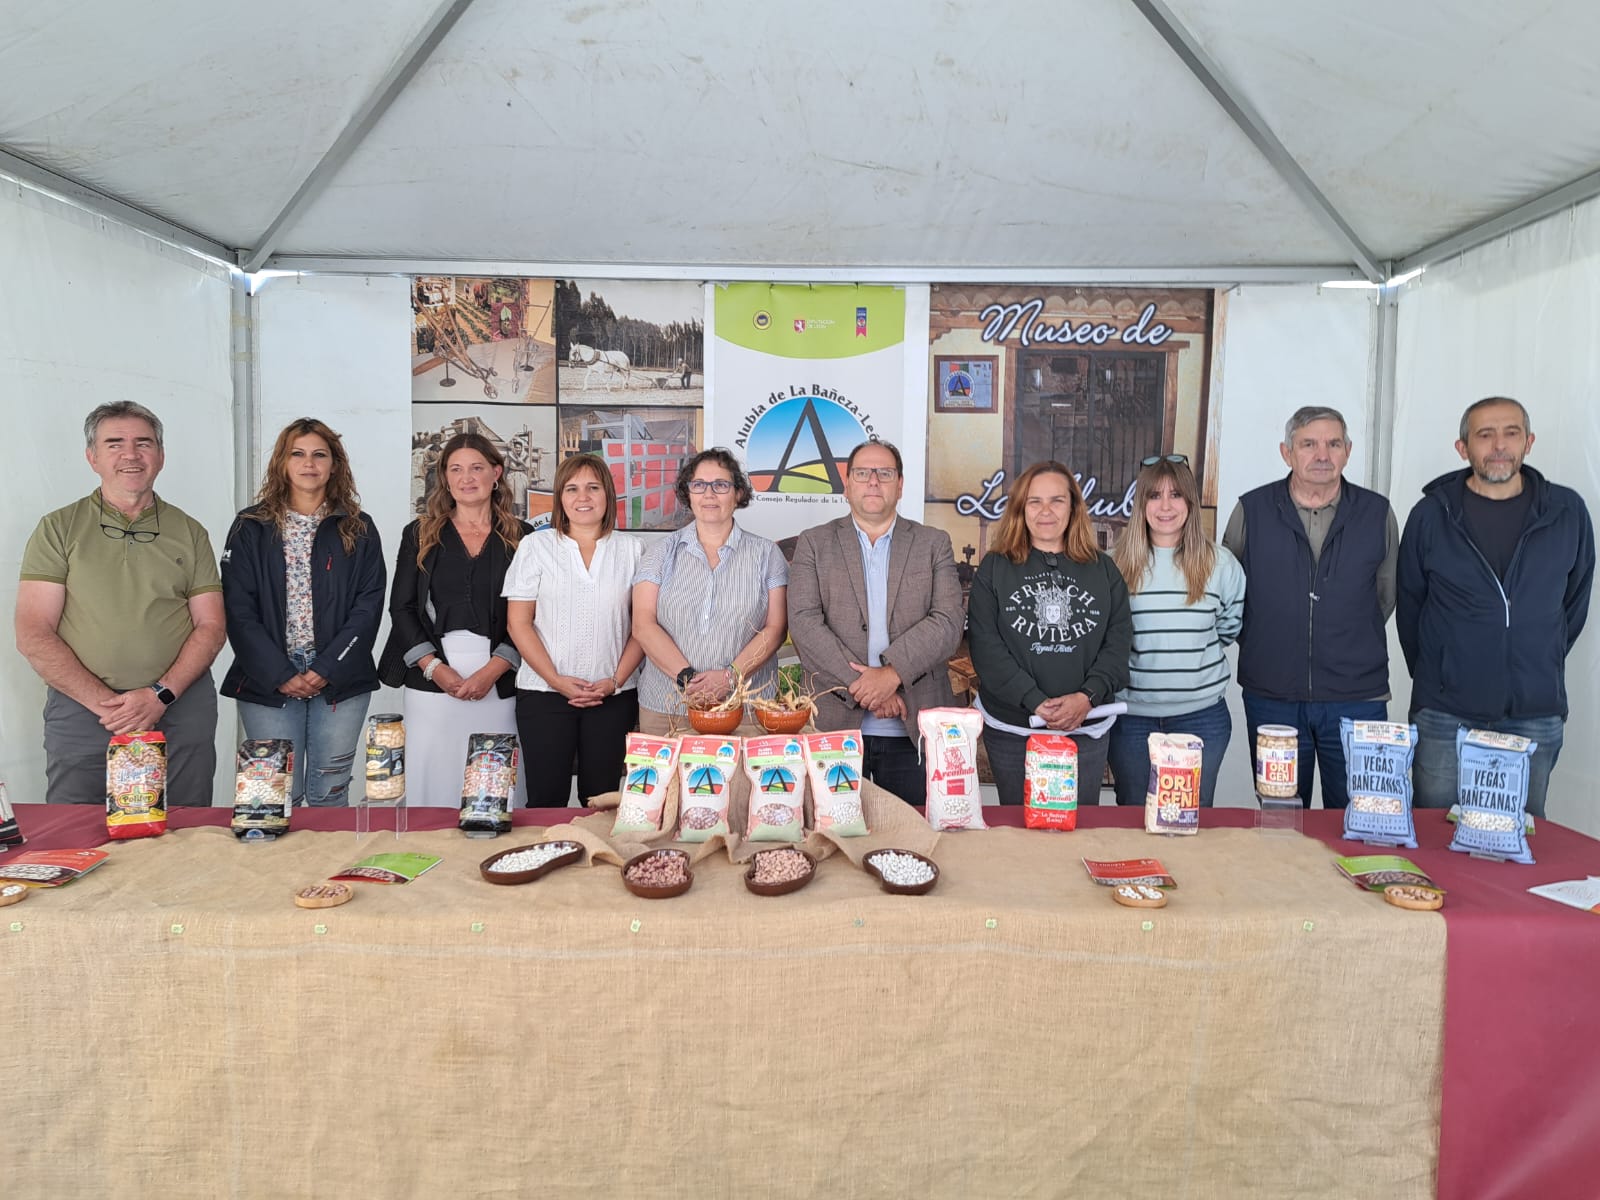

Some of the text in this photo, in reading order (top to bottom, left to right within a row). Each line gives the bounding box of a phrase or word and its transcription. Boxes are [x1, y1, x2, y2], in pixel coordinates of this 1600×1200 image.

[978, 298, 1173, 347] Museo de
[735, 383, 880, 450] Alubia de La Bañeza-Leó
[756, 494, 783, 504] Consejo
[785, 495, 819, 505] Regulador
[820, 496, 829, 504] de
[831, 496, 838, 504] la
[1074, 472, 1138, 517] lub
[1009, 580, 1096, 608] FRENCH
[1010, 615, 1099, 643] RIVIERA
[1363, 755, 1394, 775] VEGAS
[1351, 771, 1404, 796] BAÑEZANAS
[1474, 769, 1507, 790] VEGAS
[1461, 786, 1518, 814] BAÑEZANAS
